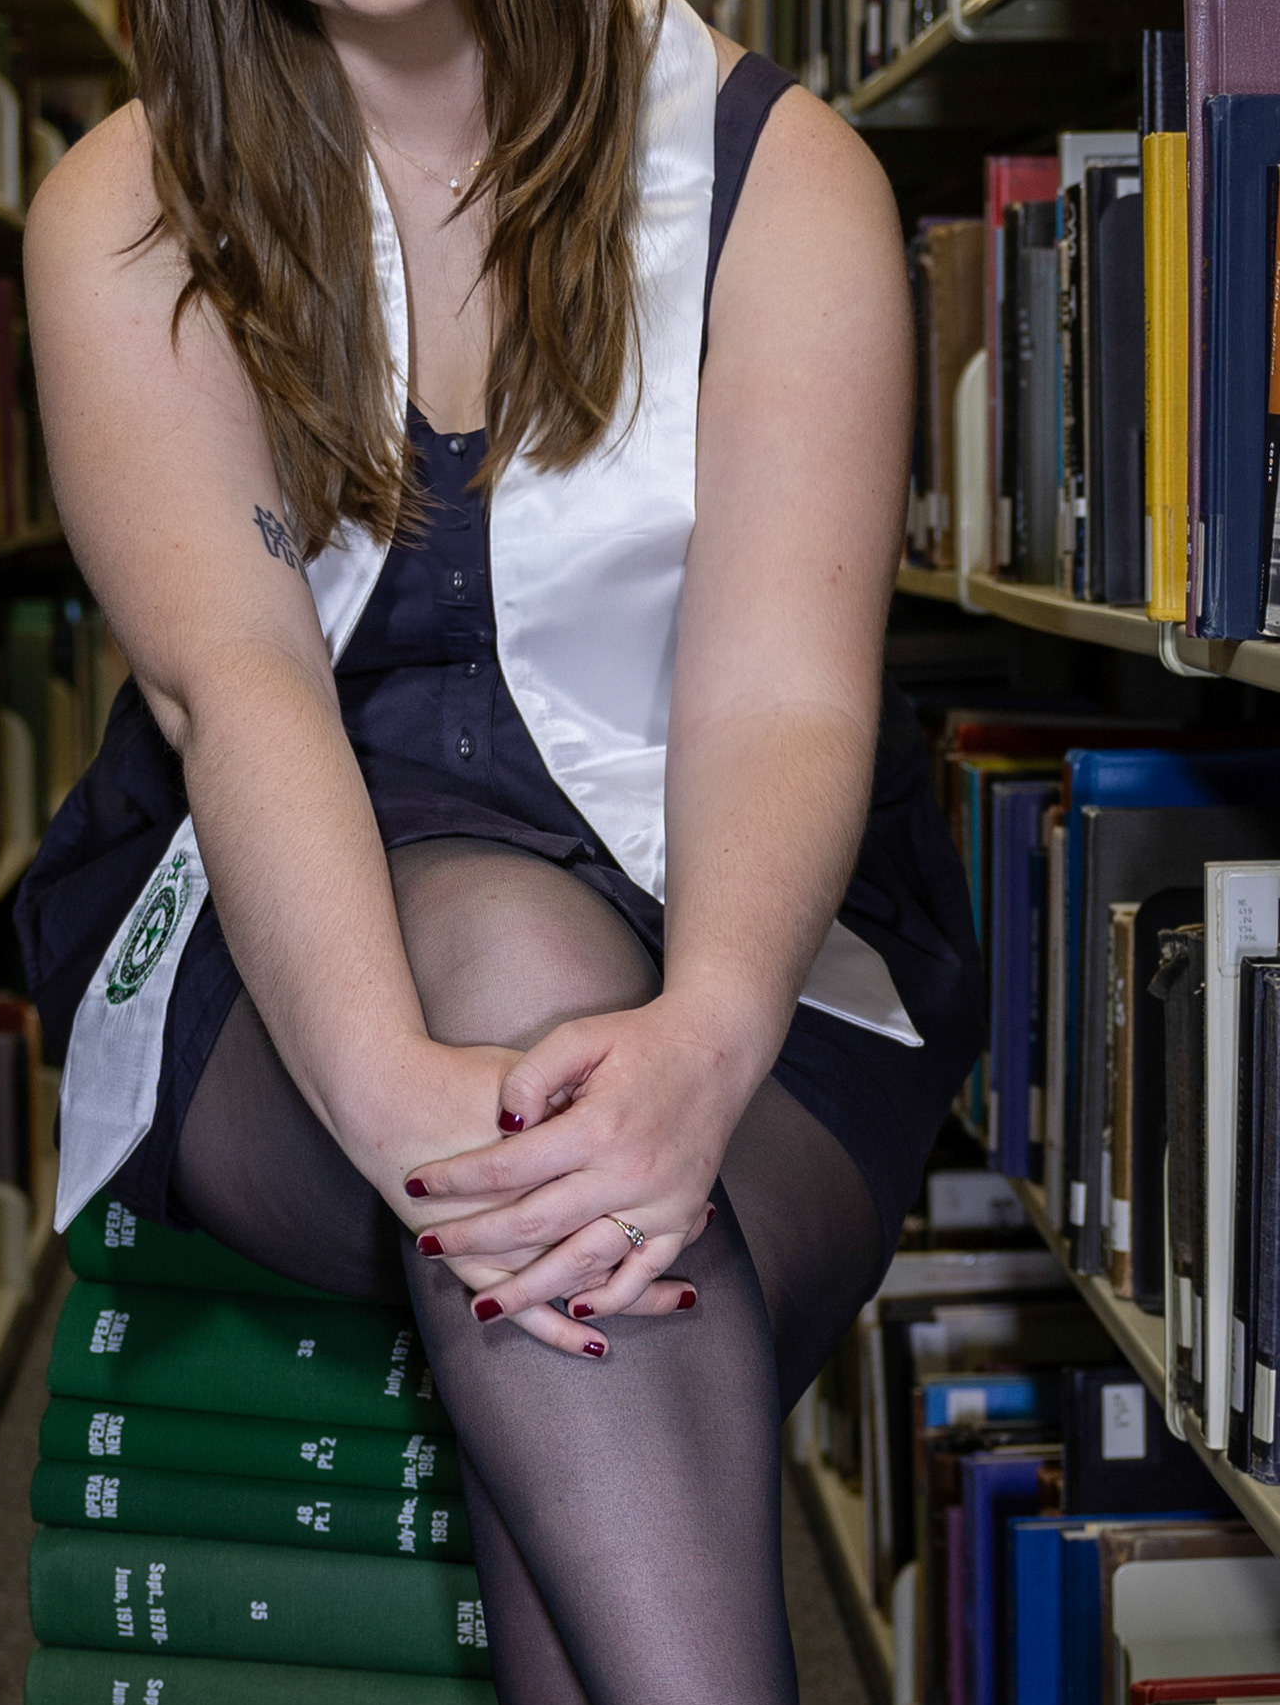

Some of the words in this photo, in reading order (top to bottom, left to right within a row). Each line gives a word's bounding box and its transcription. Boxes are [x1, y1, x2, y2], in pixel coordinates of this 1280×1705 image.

[1238, 907, 1253, 916] 419
[104, 1202, 122, 1248] OPERA
[90, 1309, 116, 1354] OPERA
[106, 1312, 130, 1353] NEWS
[297, 1339, 315, 1358] 38
[384, 1368, 405, 1398] July,
[88, 1412, 109, 1456] OPERA
[105, 1415, 124, 1456] NEWS
[320, 1436, 337, 1448] 2
[300, 1442, 318, 1462] 48
[418, 1445, 437, 1478] 1984
[85, 1474, 105, 1519] OPERA
[102, 1477, 120, 1519] NEWS
[316, 1501, 332, 1509] 1
[297, 1506, 314, 1525] 48
[397, 1496, 419, 1553] July-Dec.
[431, 1510, 449, 1543] 1983
[113, 1566, 132, 1603] June,
[116, 1605, 135, 1638] 1971
[149, 1605, 168, 1645] 1970-
[250, 1601, 268, 1621] 35
[457, 1601, 474, 1645] NEWS
